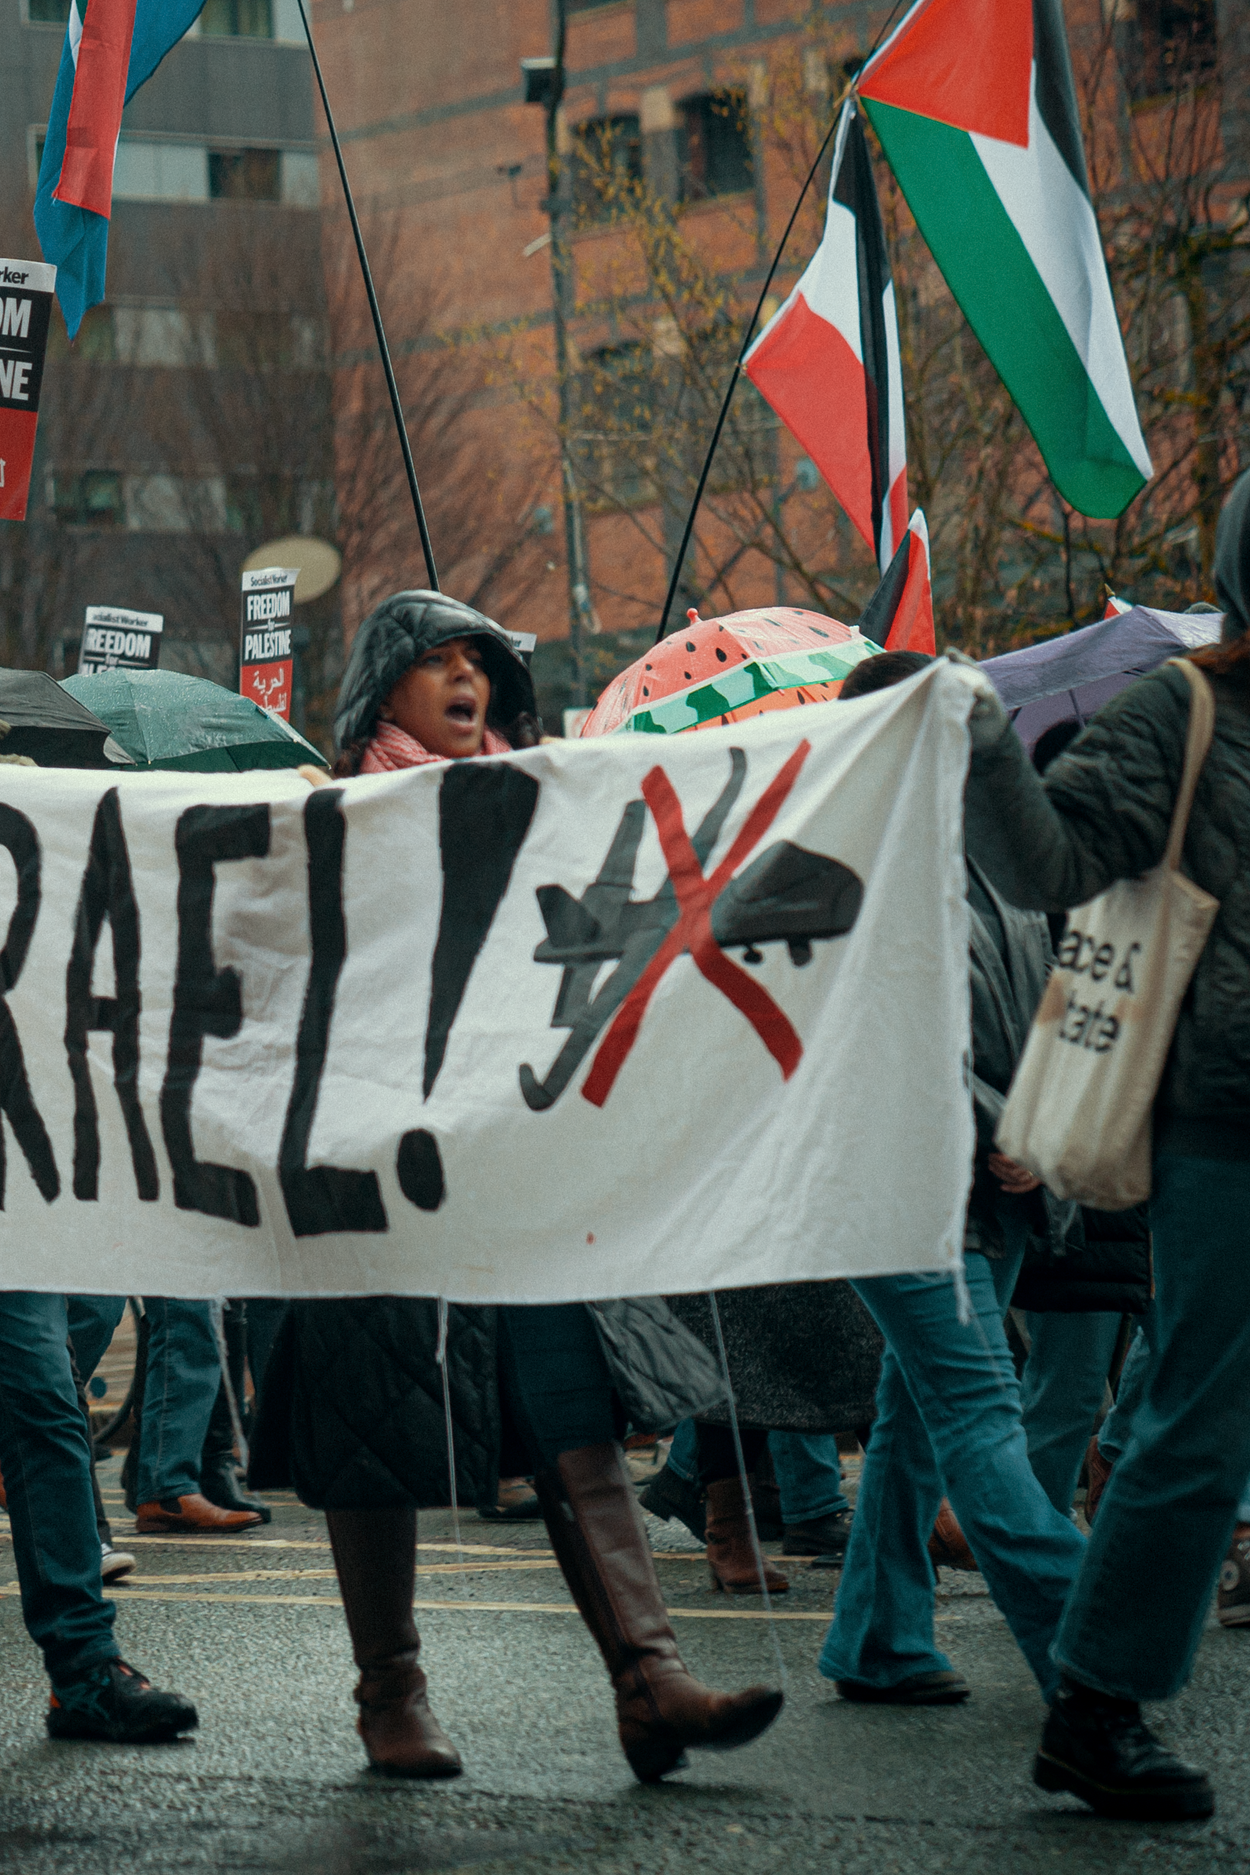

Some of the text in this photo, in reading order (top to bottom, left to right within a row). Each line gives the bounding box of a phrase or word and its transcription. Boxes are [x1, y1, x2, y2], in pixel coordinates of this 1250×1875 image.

[247, 590, 290, 621] FREEDOM
[85, 628, 152, 658] REEDOM
[244, 629, 291, 661] PALESTINE
